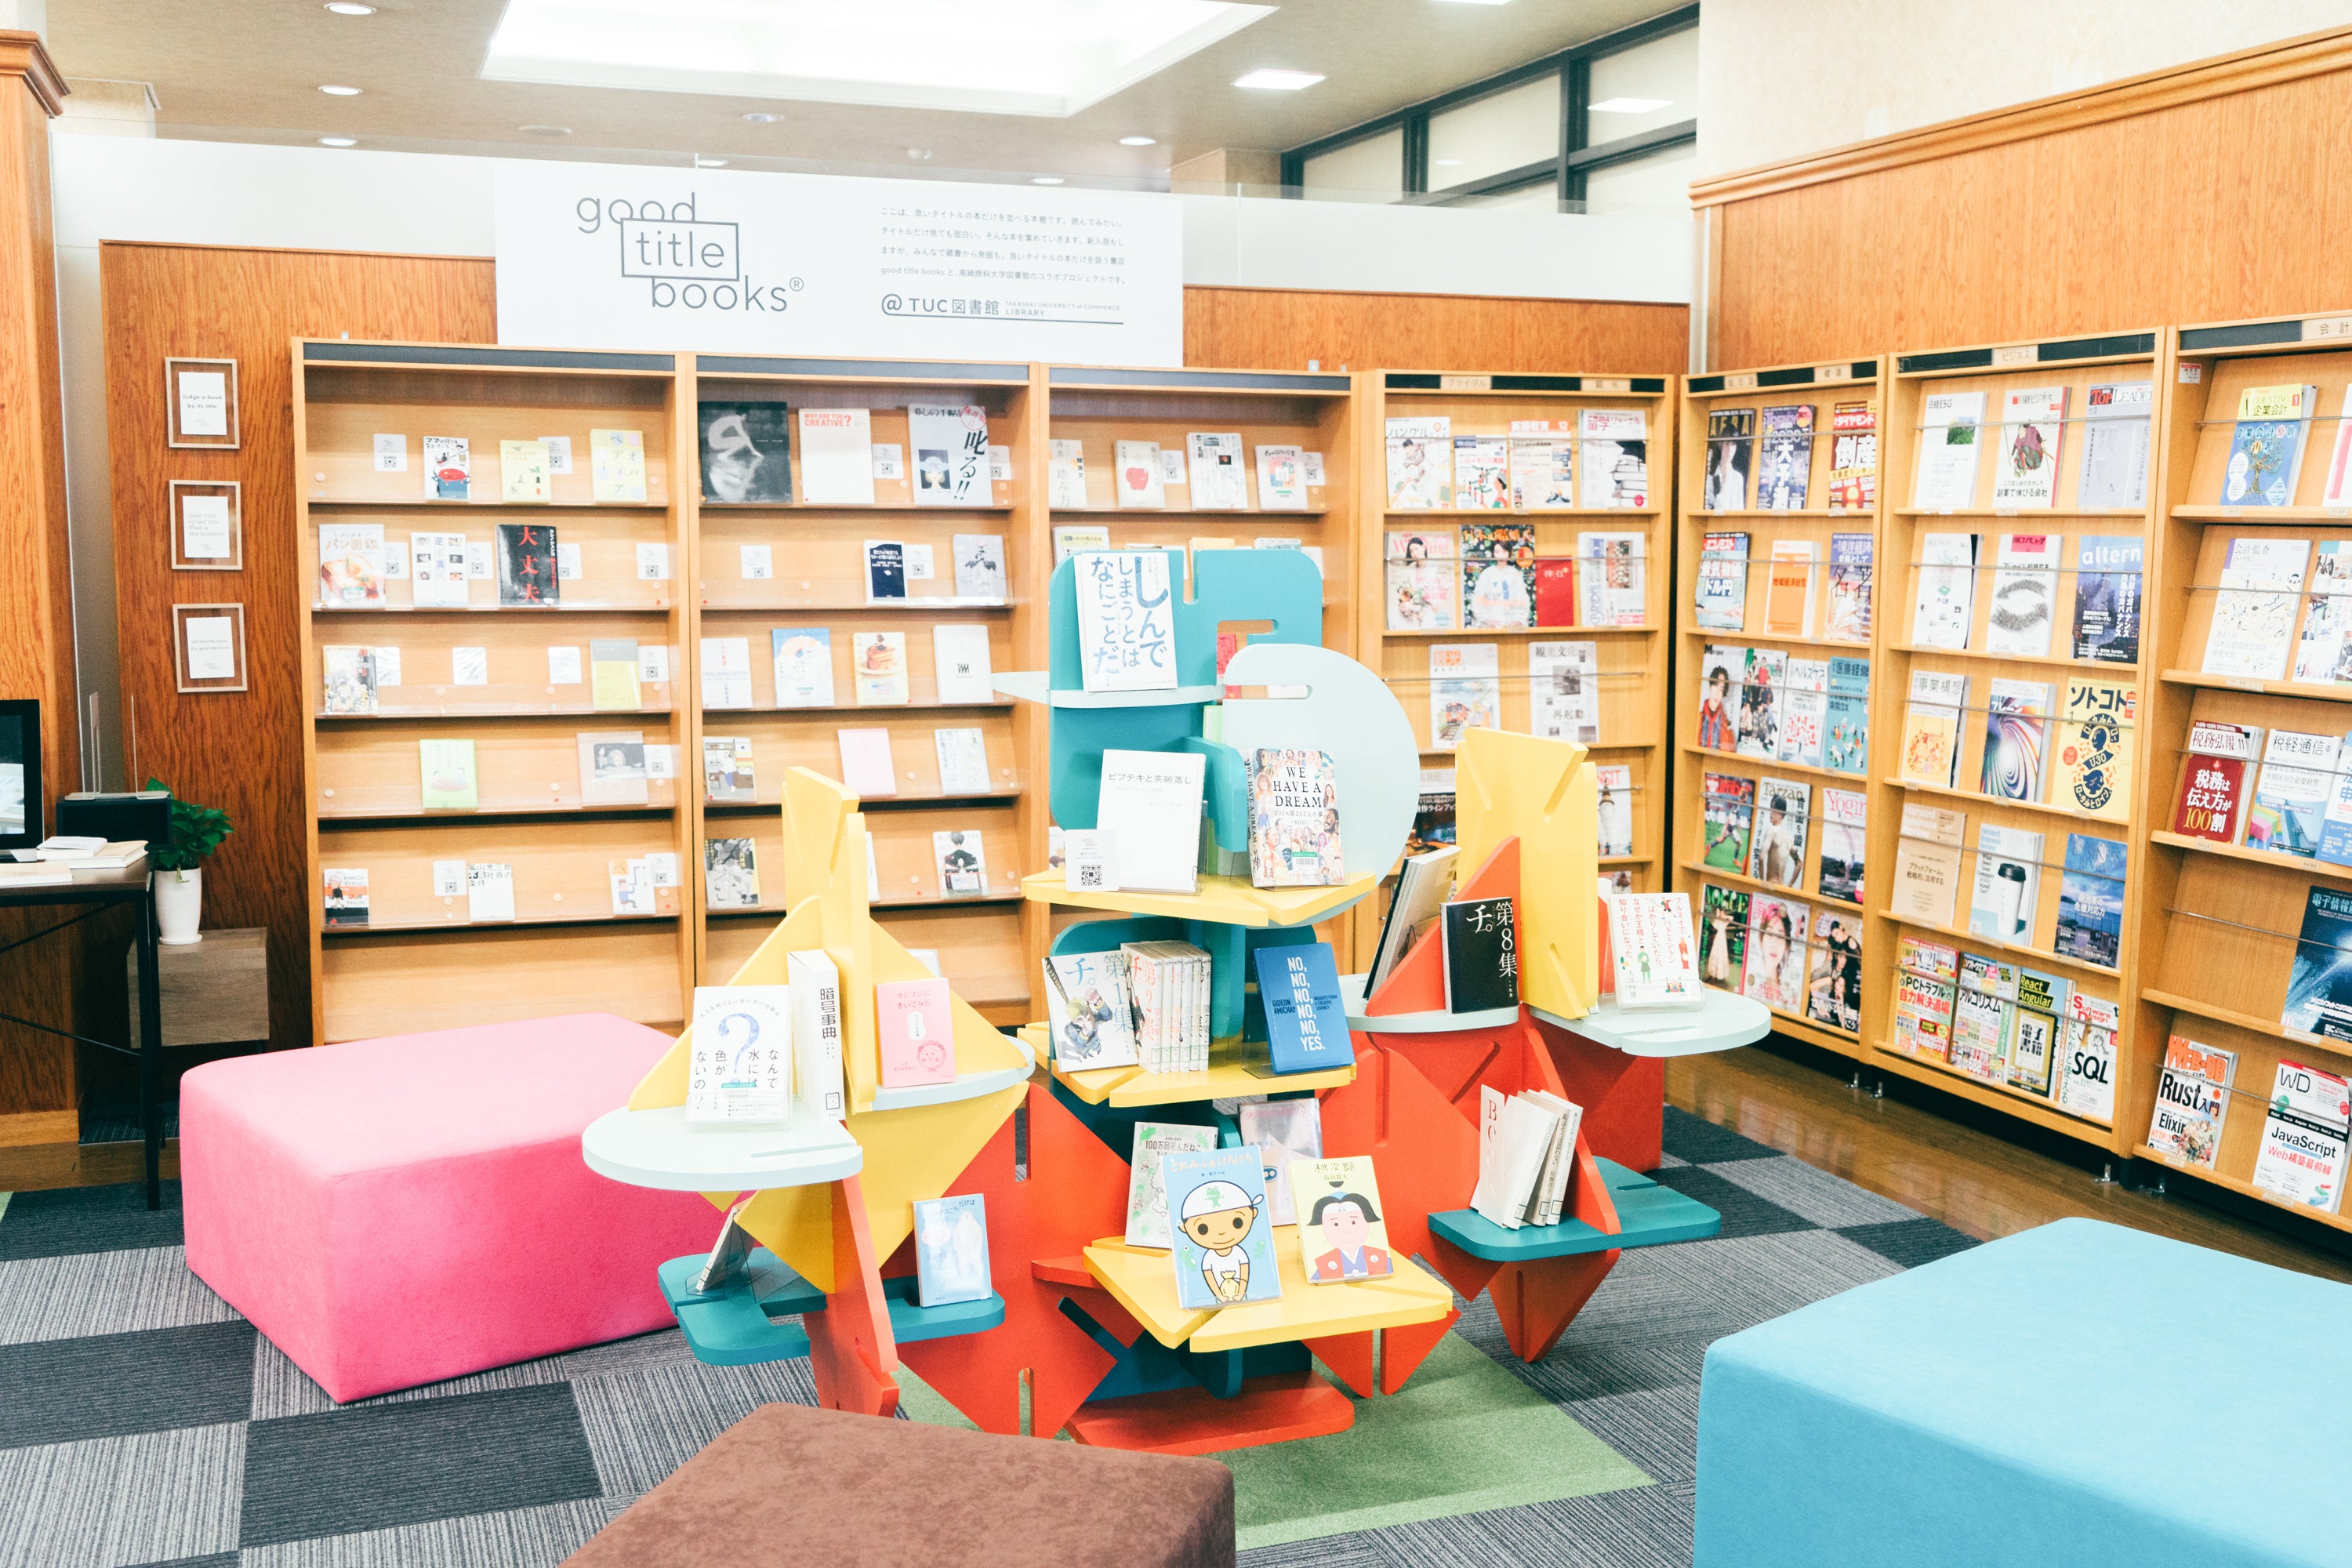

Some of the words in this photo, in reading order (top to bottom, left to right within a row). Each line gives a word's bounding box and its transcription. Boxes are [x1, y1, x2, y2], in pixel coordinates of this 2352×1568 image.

[576, 191, 695, 234] good
[636, 230, 724, 268] title
[880, 267, 901, 276] good
[1005, 308, 1045, 317] LIBRARY
[2002, 350, 2031, 361] ビジネス
[2294, 395, 2298, 405] 1
[1557, 421, 1568, 430] 12
[2082, 546, 2142, 566] altern
[1118, 556, 1141, 668] しまうとは
[1134, 557, 1169, 668] しんで
[2071, 686, 2127, 713] ソトコト
[2273, 735, 2326, 756] 税経通信
[2089, 752, 2107, 768] U30
[1109, 771, 1192, 785] ビフテキと茶碗蒸し
[1247, 766, 1253, 779] WE
[1287, 767, 1306, 778] WE
[2195, 769, 2230, 792] 税務は
[1273, 781, 1308, 793] HAVE
[1313, 782, 1322, 793] A
[1764, 781, 1806, 802] Tarzan
[1276, 796, 1323, 808] DREAM
[2187, 787, 2232, 812] 伝え方が
[2184, 807, 2227, 833] 100割
[1495, 901, 1518, 978] 第8集
[1065, 957, 1096, 987] チ。
[1287, 956, 1307, 972] NO,
[1290, 972, 1310, 988] NO,
[1906, 976, 1946, 998] PCトラブル
[2020, 975, 2044, 992] React
[1294, 988, 1313, 1004] NO,
[1900, 988, 1951, 1015] 自力解決道場
[2019, 989, 2052, 1007] Angular
[2073, 995, 2111, 1018] Software
[820, 987, 837, 1040] 暗号事典
[1274, 1006, 1295, 1014] AMICHAY
[1296, 1004, 1316, 1019] NO,
[1300, 1020, 1319, 1035] NO,
[1300, 1036, 1326, 1051] YES.
[714, 1050, 727, 1076] 色が
[768, 1050, 779, 1089] なんて
[2072, 1051, 2110, 1084] SQL
[2280, 1067, 2310, 1093] WD
[2158, 1112, 2186, 1134] Elixir
[1145, 1140, 1202, 1153] 100万回死んだねこ
[2271, 1126, 2337, 1159] JavaScript
[2267, 1144, 2332, 1176] Web構築最前線
